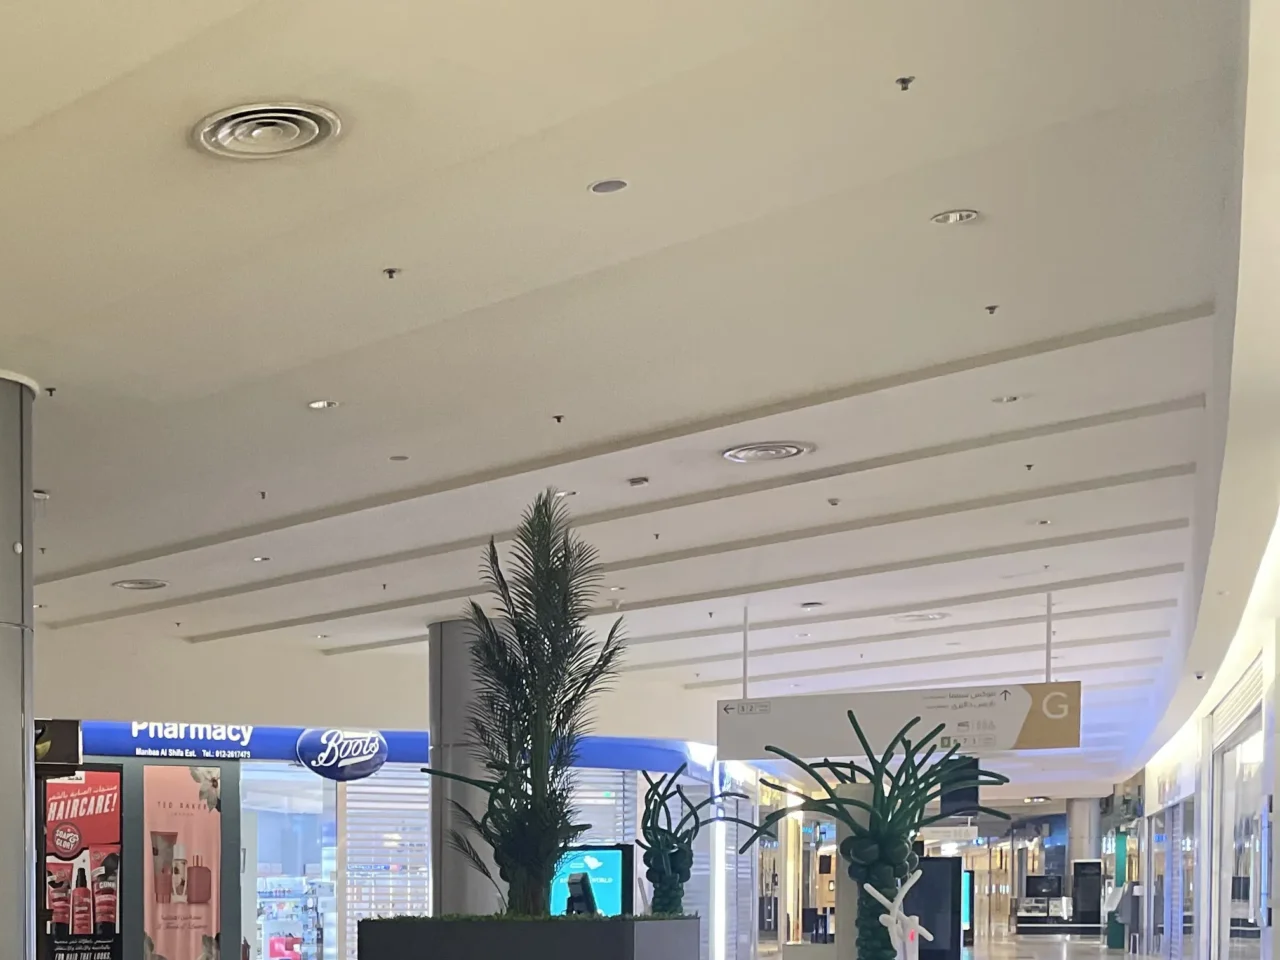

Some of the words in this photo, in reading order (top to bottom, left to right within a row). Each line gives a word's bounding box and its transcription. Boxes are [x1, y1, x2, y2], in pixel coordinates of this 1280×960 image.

[1042, 691, 1069, 719] G
[131, 720, 254, 747] Pharmacy
[160, 749, 168, 757] Al
[185, 749, 197, 757] Est.
[311, 728, 380, 768] Boots
[47, 792, 118, 822] HAIRCARE!
[157, 801, 173, 809] TED
[55, 829, 70, 840] SOAP
[56, 838, 74, 850] GLORY
